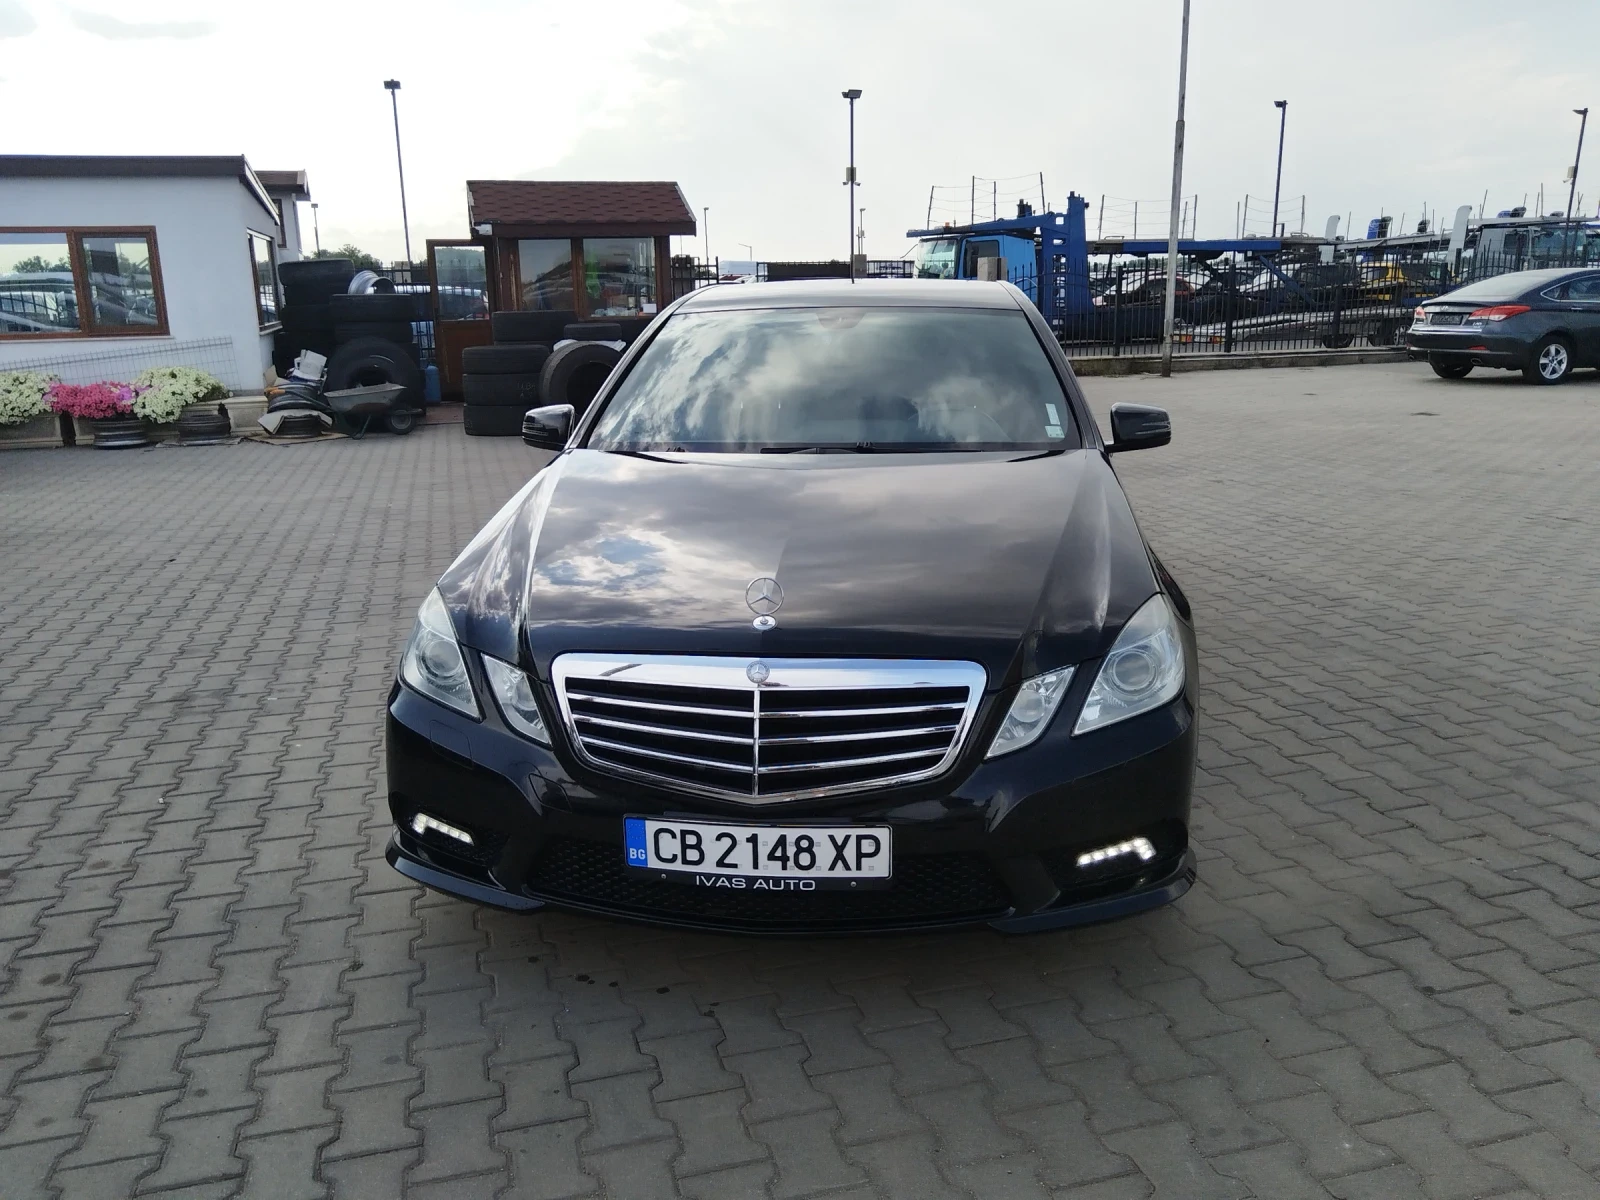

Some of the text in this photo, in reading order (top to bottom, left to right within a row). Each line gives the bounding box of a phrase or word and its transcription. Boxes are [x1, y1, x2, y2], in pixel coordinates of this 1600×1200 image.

[629, 848, 646, 860] BG
[653, 827, 881, 871] CB 2148 XP
[696, 875, 816, 891] IVAS AUTO
